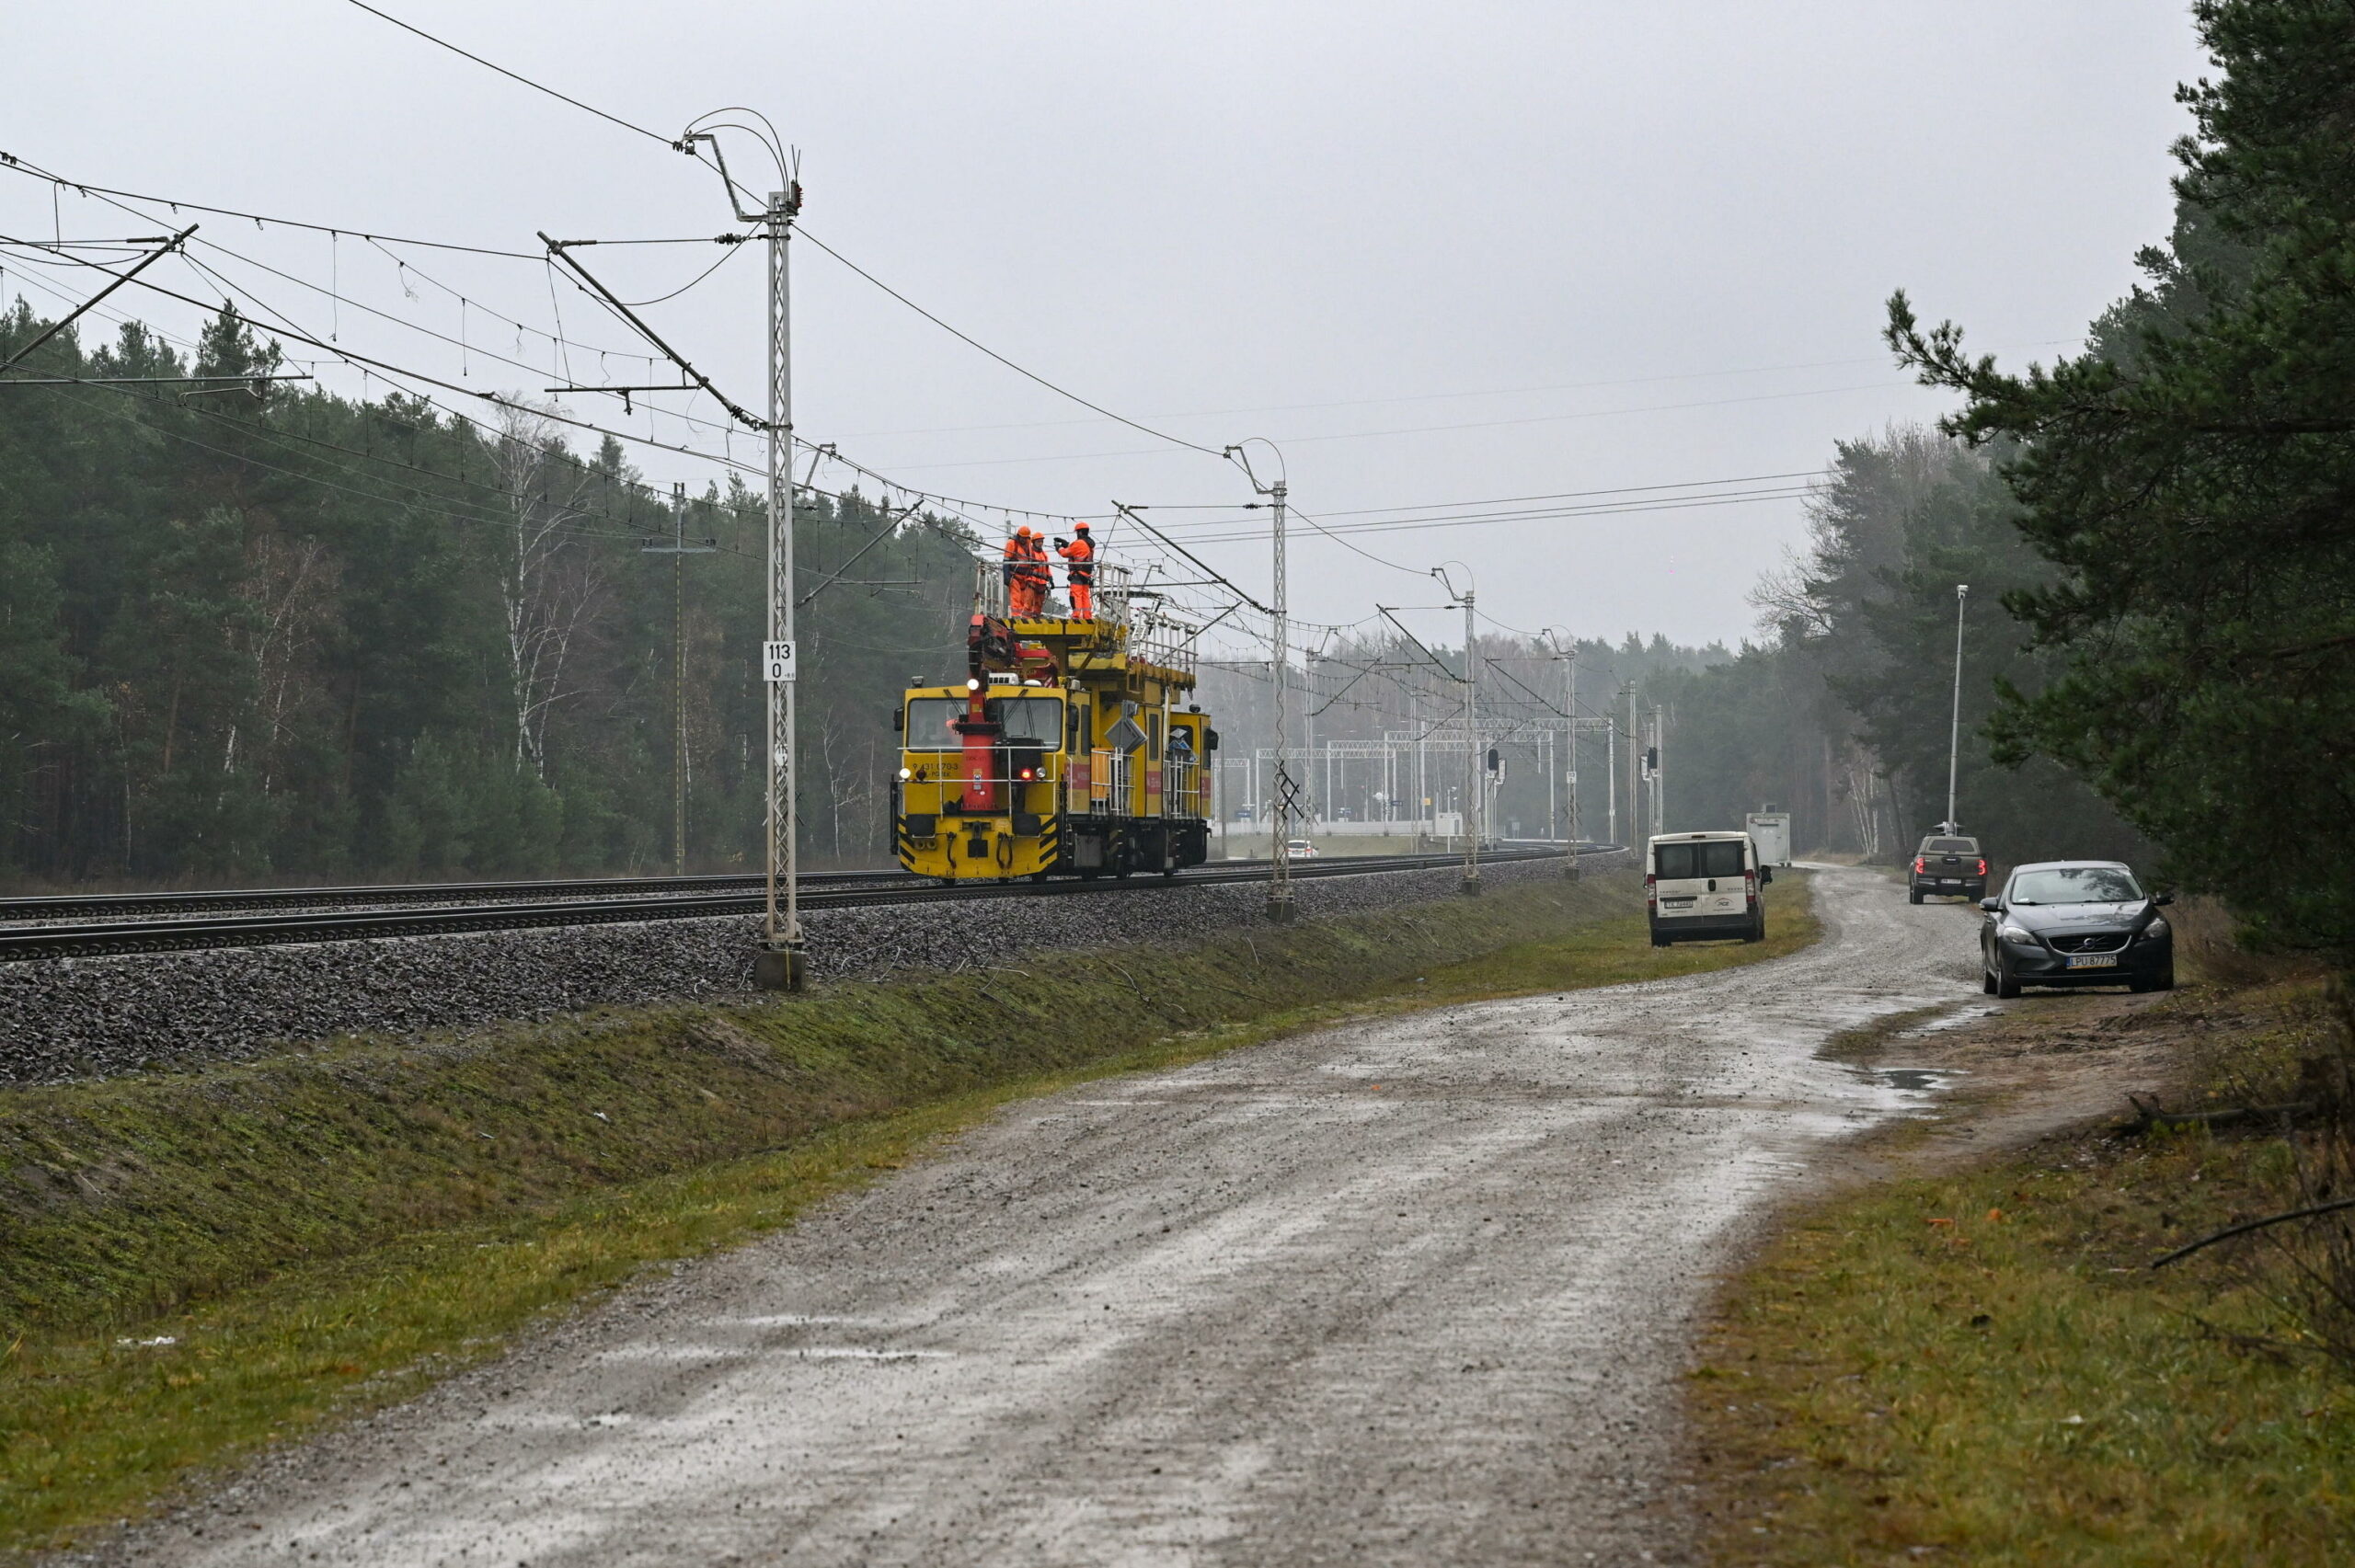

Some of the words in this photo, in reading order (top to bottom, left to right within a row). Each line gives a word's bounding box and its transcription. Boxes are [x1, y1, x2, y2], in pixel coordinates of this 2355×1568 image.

[769, 644, 790, 659] 113
[772, 663, 781, 678] 0
[2071, 956, 2088, 967] LPU
[2089, 956, 2116, 966] 87775
